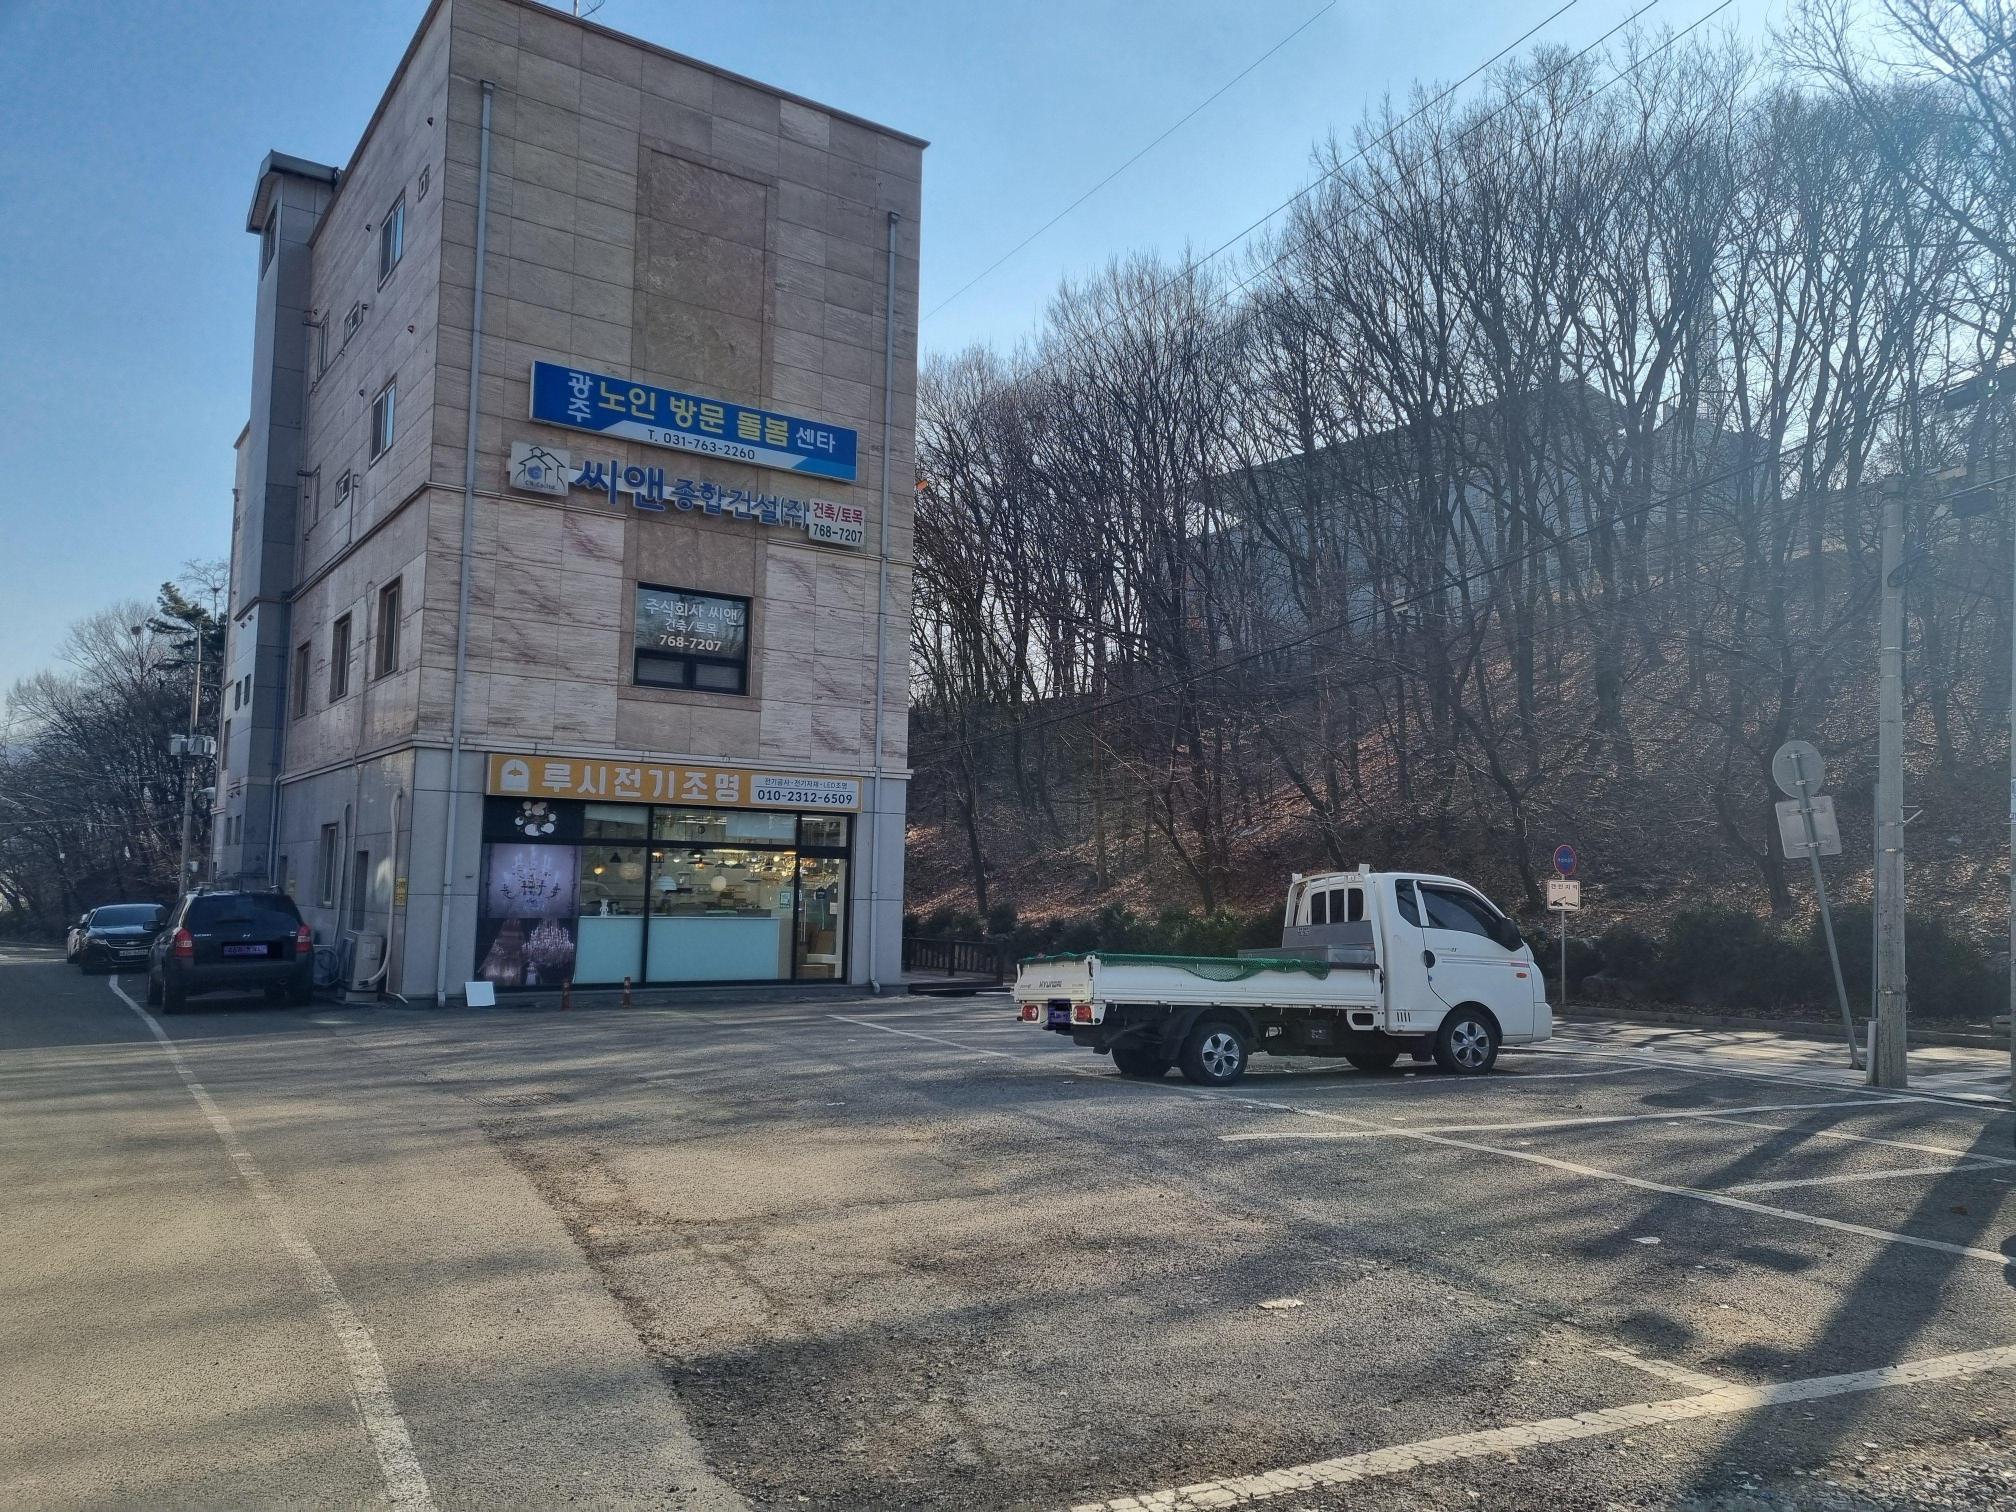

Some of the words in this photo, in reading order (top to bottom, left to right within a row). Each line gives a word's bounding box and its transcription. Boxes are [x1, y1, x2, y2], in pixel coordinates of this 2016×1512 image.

[567, 371, 595, 423] 광주
[598, 381, 656, 420] 노인
[669, 396, 725, 435] 방문
[795, 426, 836, 453] 센타
[647, 428, 658, 442] T.
[663, 432, 756, 460] 031-763-2260
[573, 459, 666, 512] 씨앤
[813, 501, 864, 526] 건축/토목
[813, 523, 863, 543] 768-7207
[645, 598, 705, 618] 주식회사
[707, 606, 737, 625] 씨앤
[665, 618, 718, 637] 건축/토목
[660, 634, 722, 652] 768-7207
[541, 762, 740, 802] 루시전기조명
[757, 789, 853, 805] 010-2312-6509
